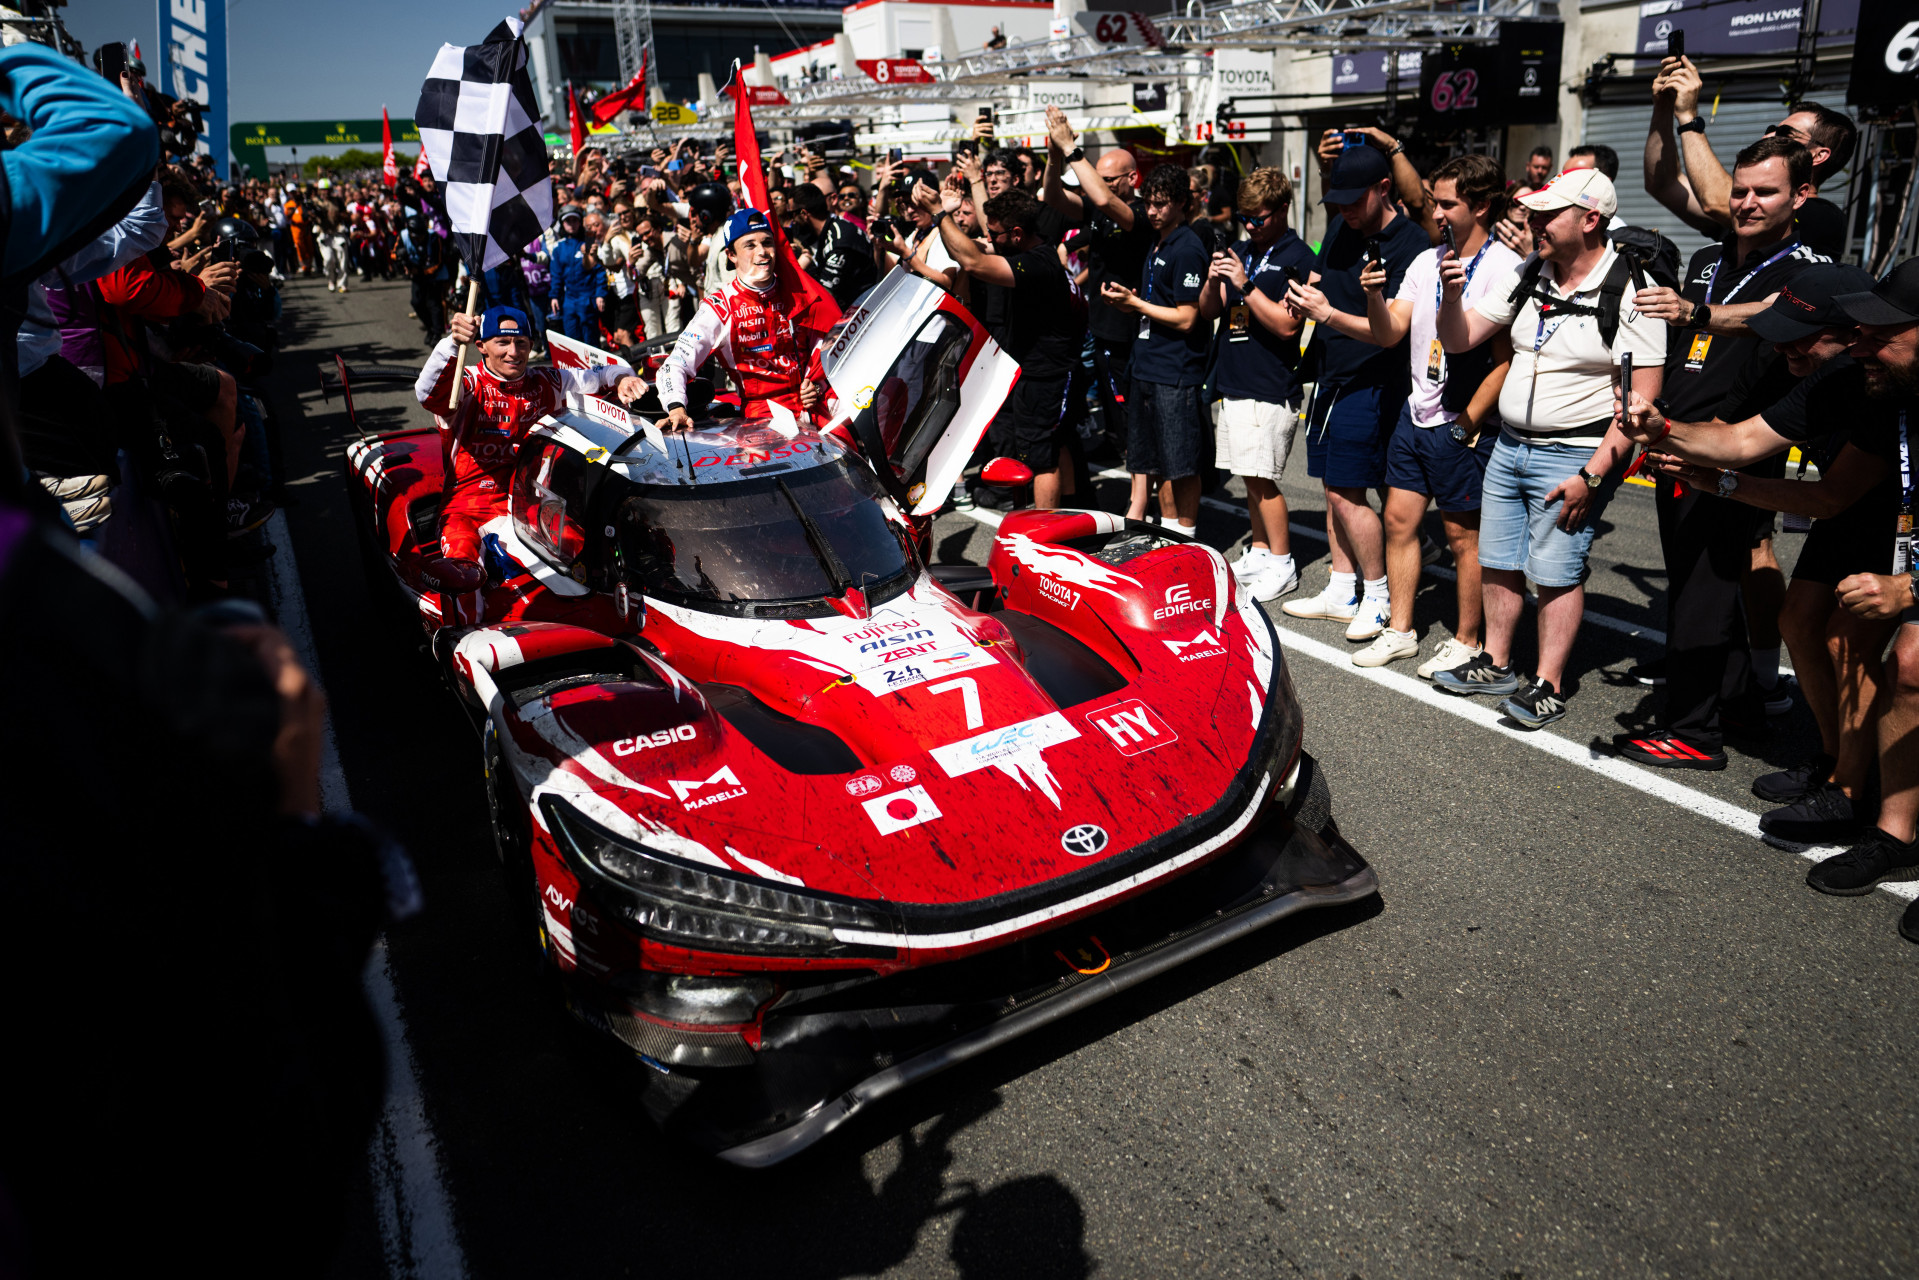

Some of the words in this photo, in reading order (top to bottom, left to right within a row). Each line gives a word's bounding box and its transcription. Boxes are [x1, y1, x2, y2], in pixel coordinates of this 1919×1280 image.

[1731, 13, 1765, 27] IRON
[1766, 7, 1801, 22] LYNX
[1097, 14, 1128, 43] 62
[1885, 20, 1919, 73] 6
[876, 60, 889, 82] 8
[1218, 69, 1271, 84] TOYOTA
[1033, 92, 1081, 105] TOYOTA
[1431, 68, 1479, 112] 62
[656, 106, 680, 120] 28
[245, 136, 282, 146] ROLEX
[325, 134, 360, 143] ROLEX
[738, 317, 765, 329] AISIN
[830, 307, 870, 359] TOYOTA
[738, 332, 761, 343] Mobil
[596, 400, 627, 423] TOYOTA
[692, 442, 812, 467] DENSO
[1038, 589, 1071, 607] RACING
[1040, 575, 1071, 602] TOYOTA
[1071, 591, 1081, 611] 7
[1153, 598, 1212, 620] EDIFICE
[842, 619, 921, 643] FUJITSU
[859, 629, 934, 653] AISIN
[877, 641, 937, 663] ZENT
[1179, 647, 1227, 662] MARELLI
[883, 665, 921, 683] 24h
[926, 676, 984, 731] 7
[1096, 706, 1159, 748] HY
[612, 724, 697, 757] CASIO
[971, 723, 1034, 755] WEC
[847, 776, 880, 796] FIA
[683, 786, 748, 812] MARELLI
